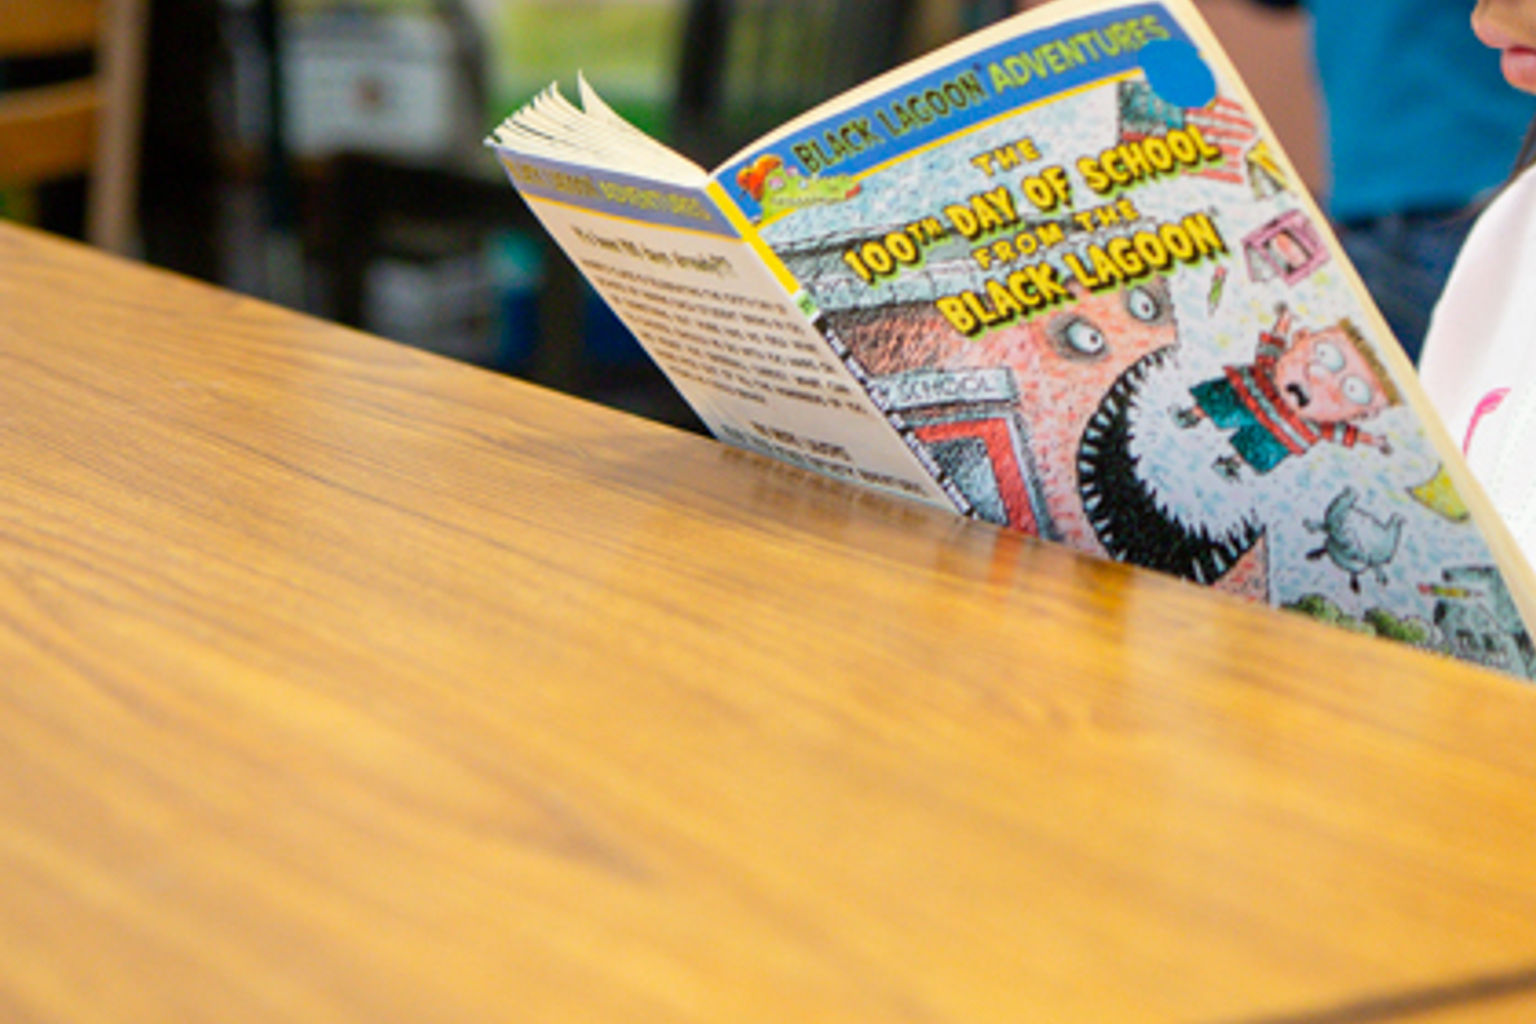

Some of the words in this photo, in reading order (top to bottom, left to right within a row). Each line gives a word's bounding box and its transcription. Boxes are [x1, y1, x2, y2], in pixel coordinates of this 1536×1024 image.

[792, 116, 884, 175] BLACK
[875, 69, 989, 137] LAGOON
[987, 14, 1171, 94] ADVENTURES
[843, 217, 948, 284] 100TH
[944, 186, 1019, 239] DAY
[1021, 165, 1072, 210] OF
[1076, 124, 1222, 197] SCHOOL
[971, 136, 1041, 177] THE
[936, 261, 1076, 335] BLACK
[1063, 212, 1229, 290] LAGOON
[972, 222, 1066, 271] FROM
[1073, 197, 1142, 234] THE
[899, 374, 996, 400] SCHOOL
